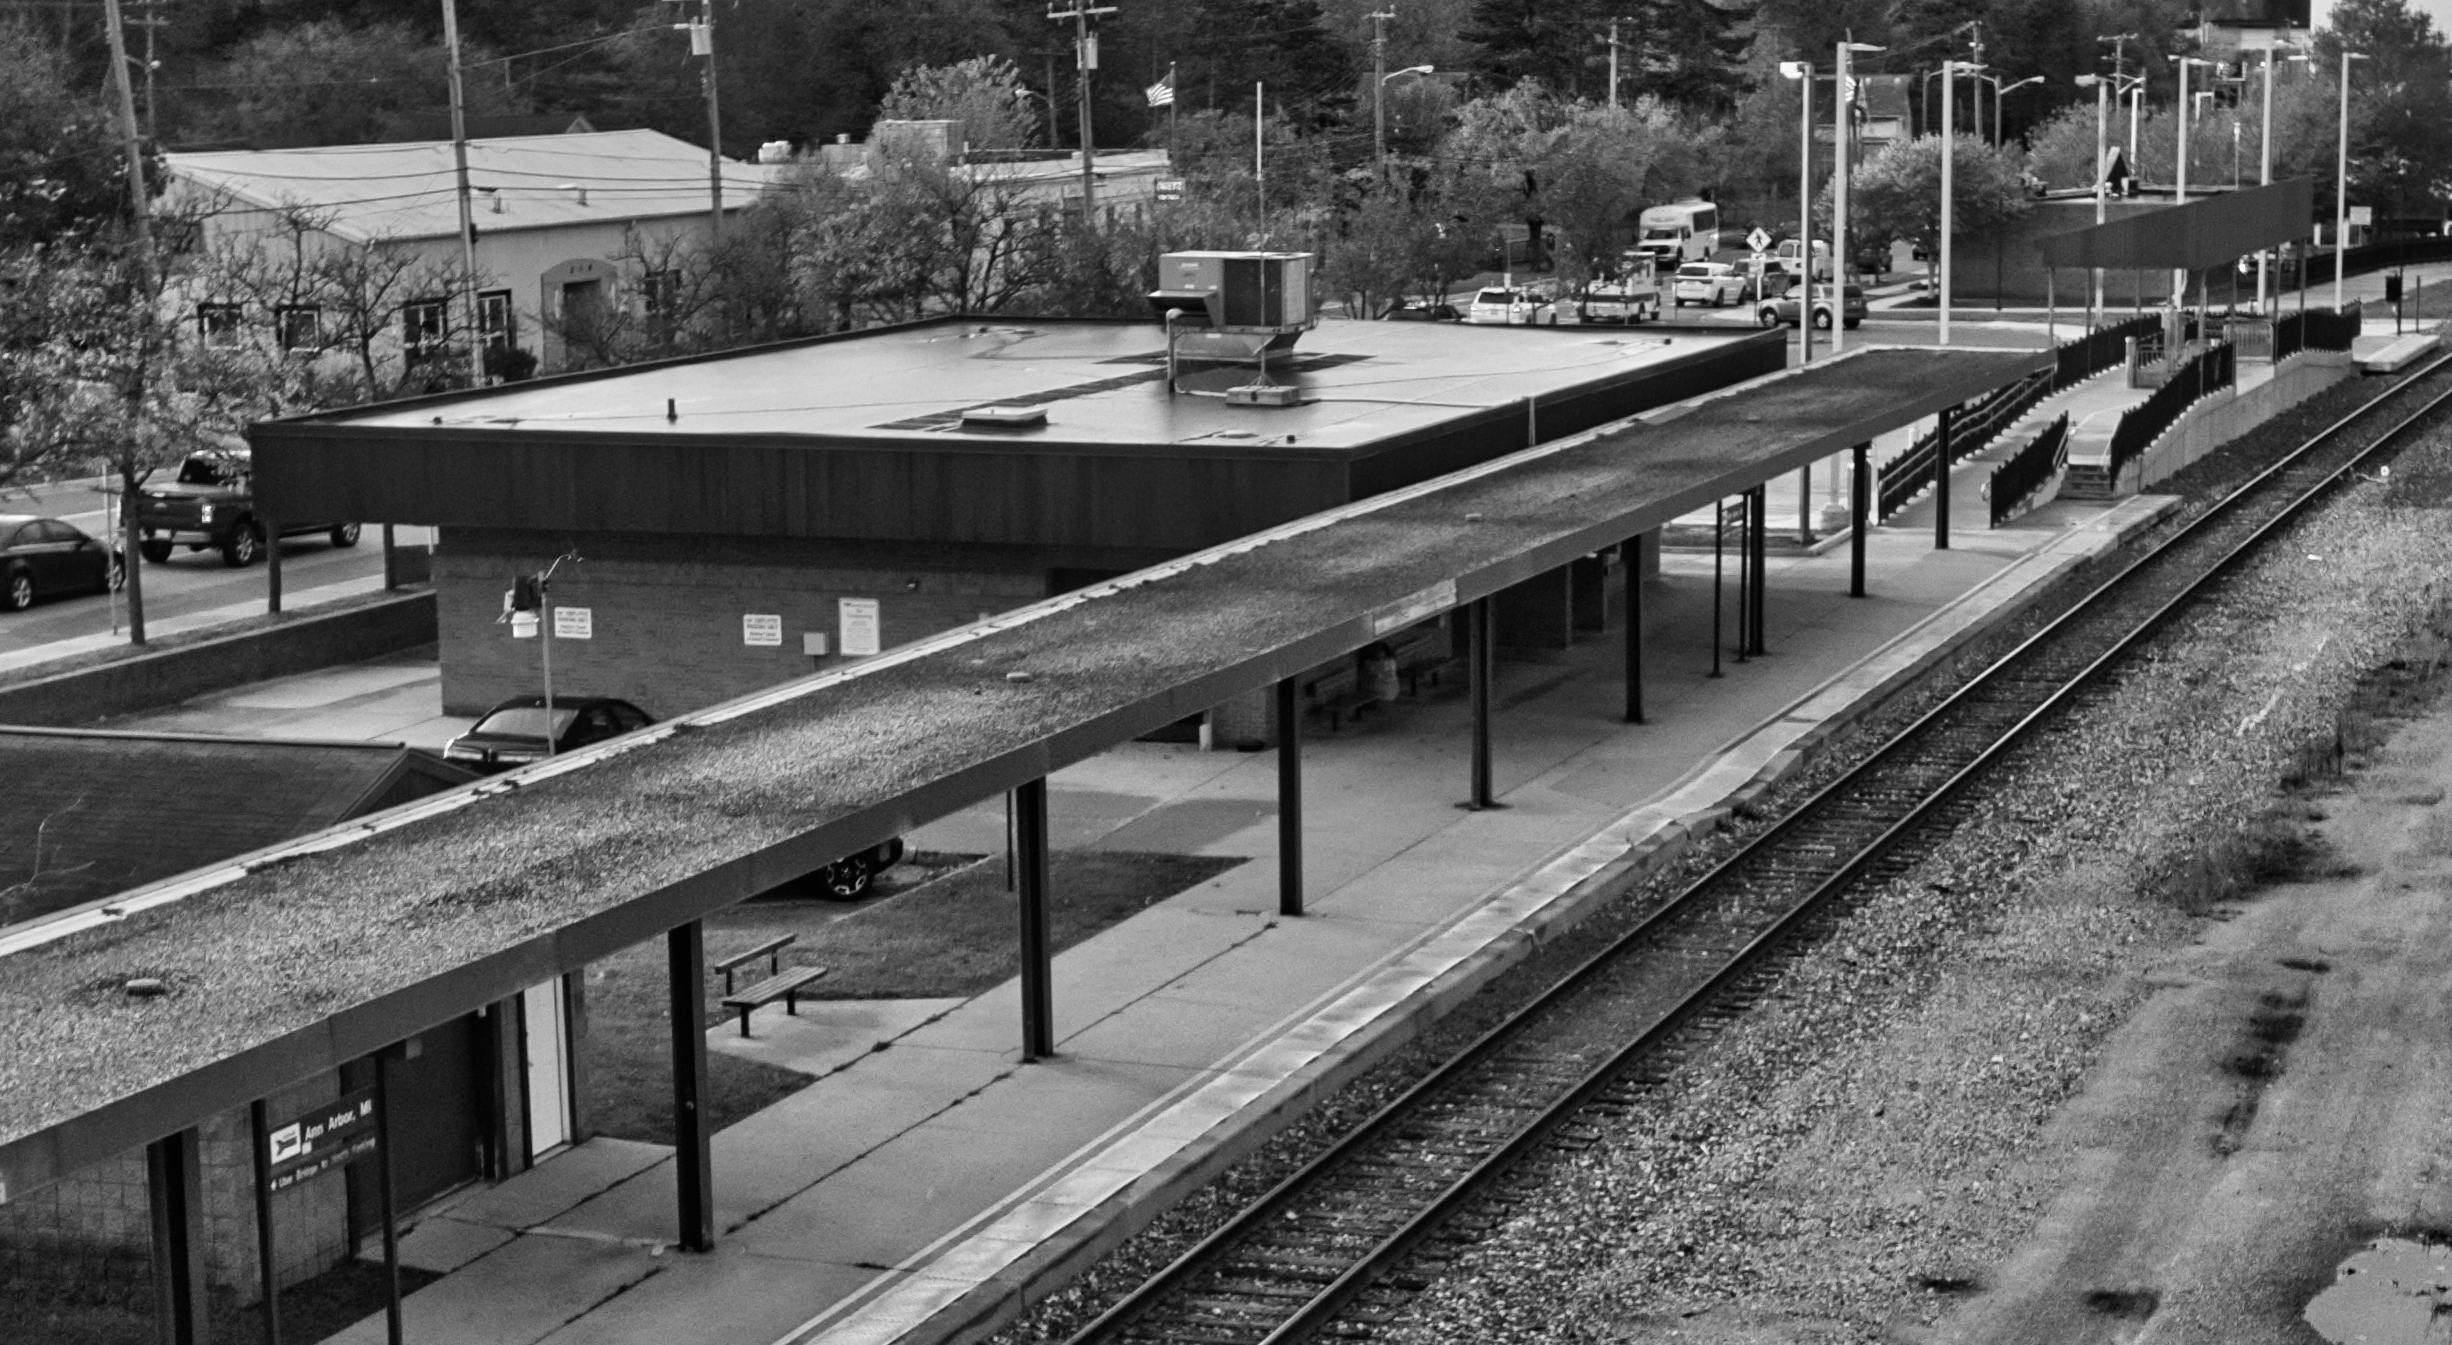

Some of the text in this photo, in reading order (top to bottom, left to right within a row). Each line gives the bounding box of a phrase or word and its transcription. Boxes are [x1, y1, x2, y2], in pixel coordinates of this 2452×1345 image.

[305, 1125, 324, 1141] Ann
[328, 1109, 356, 1132] Arbor,
[360, 1099, 372, 1117] MI
